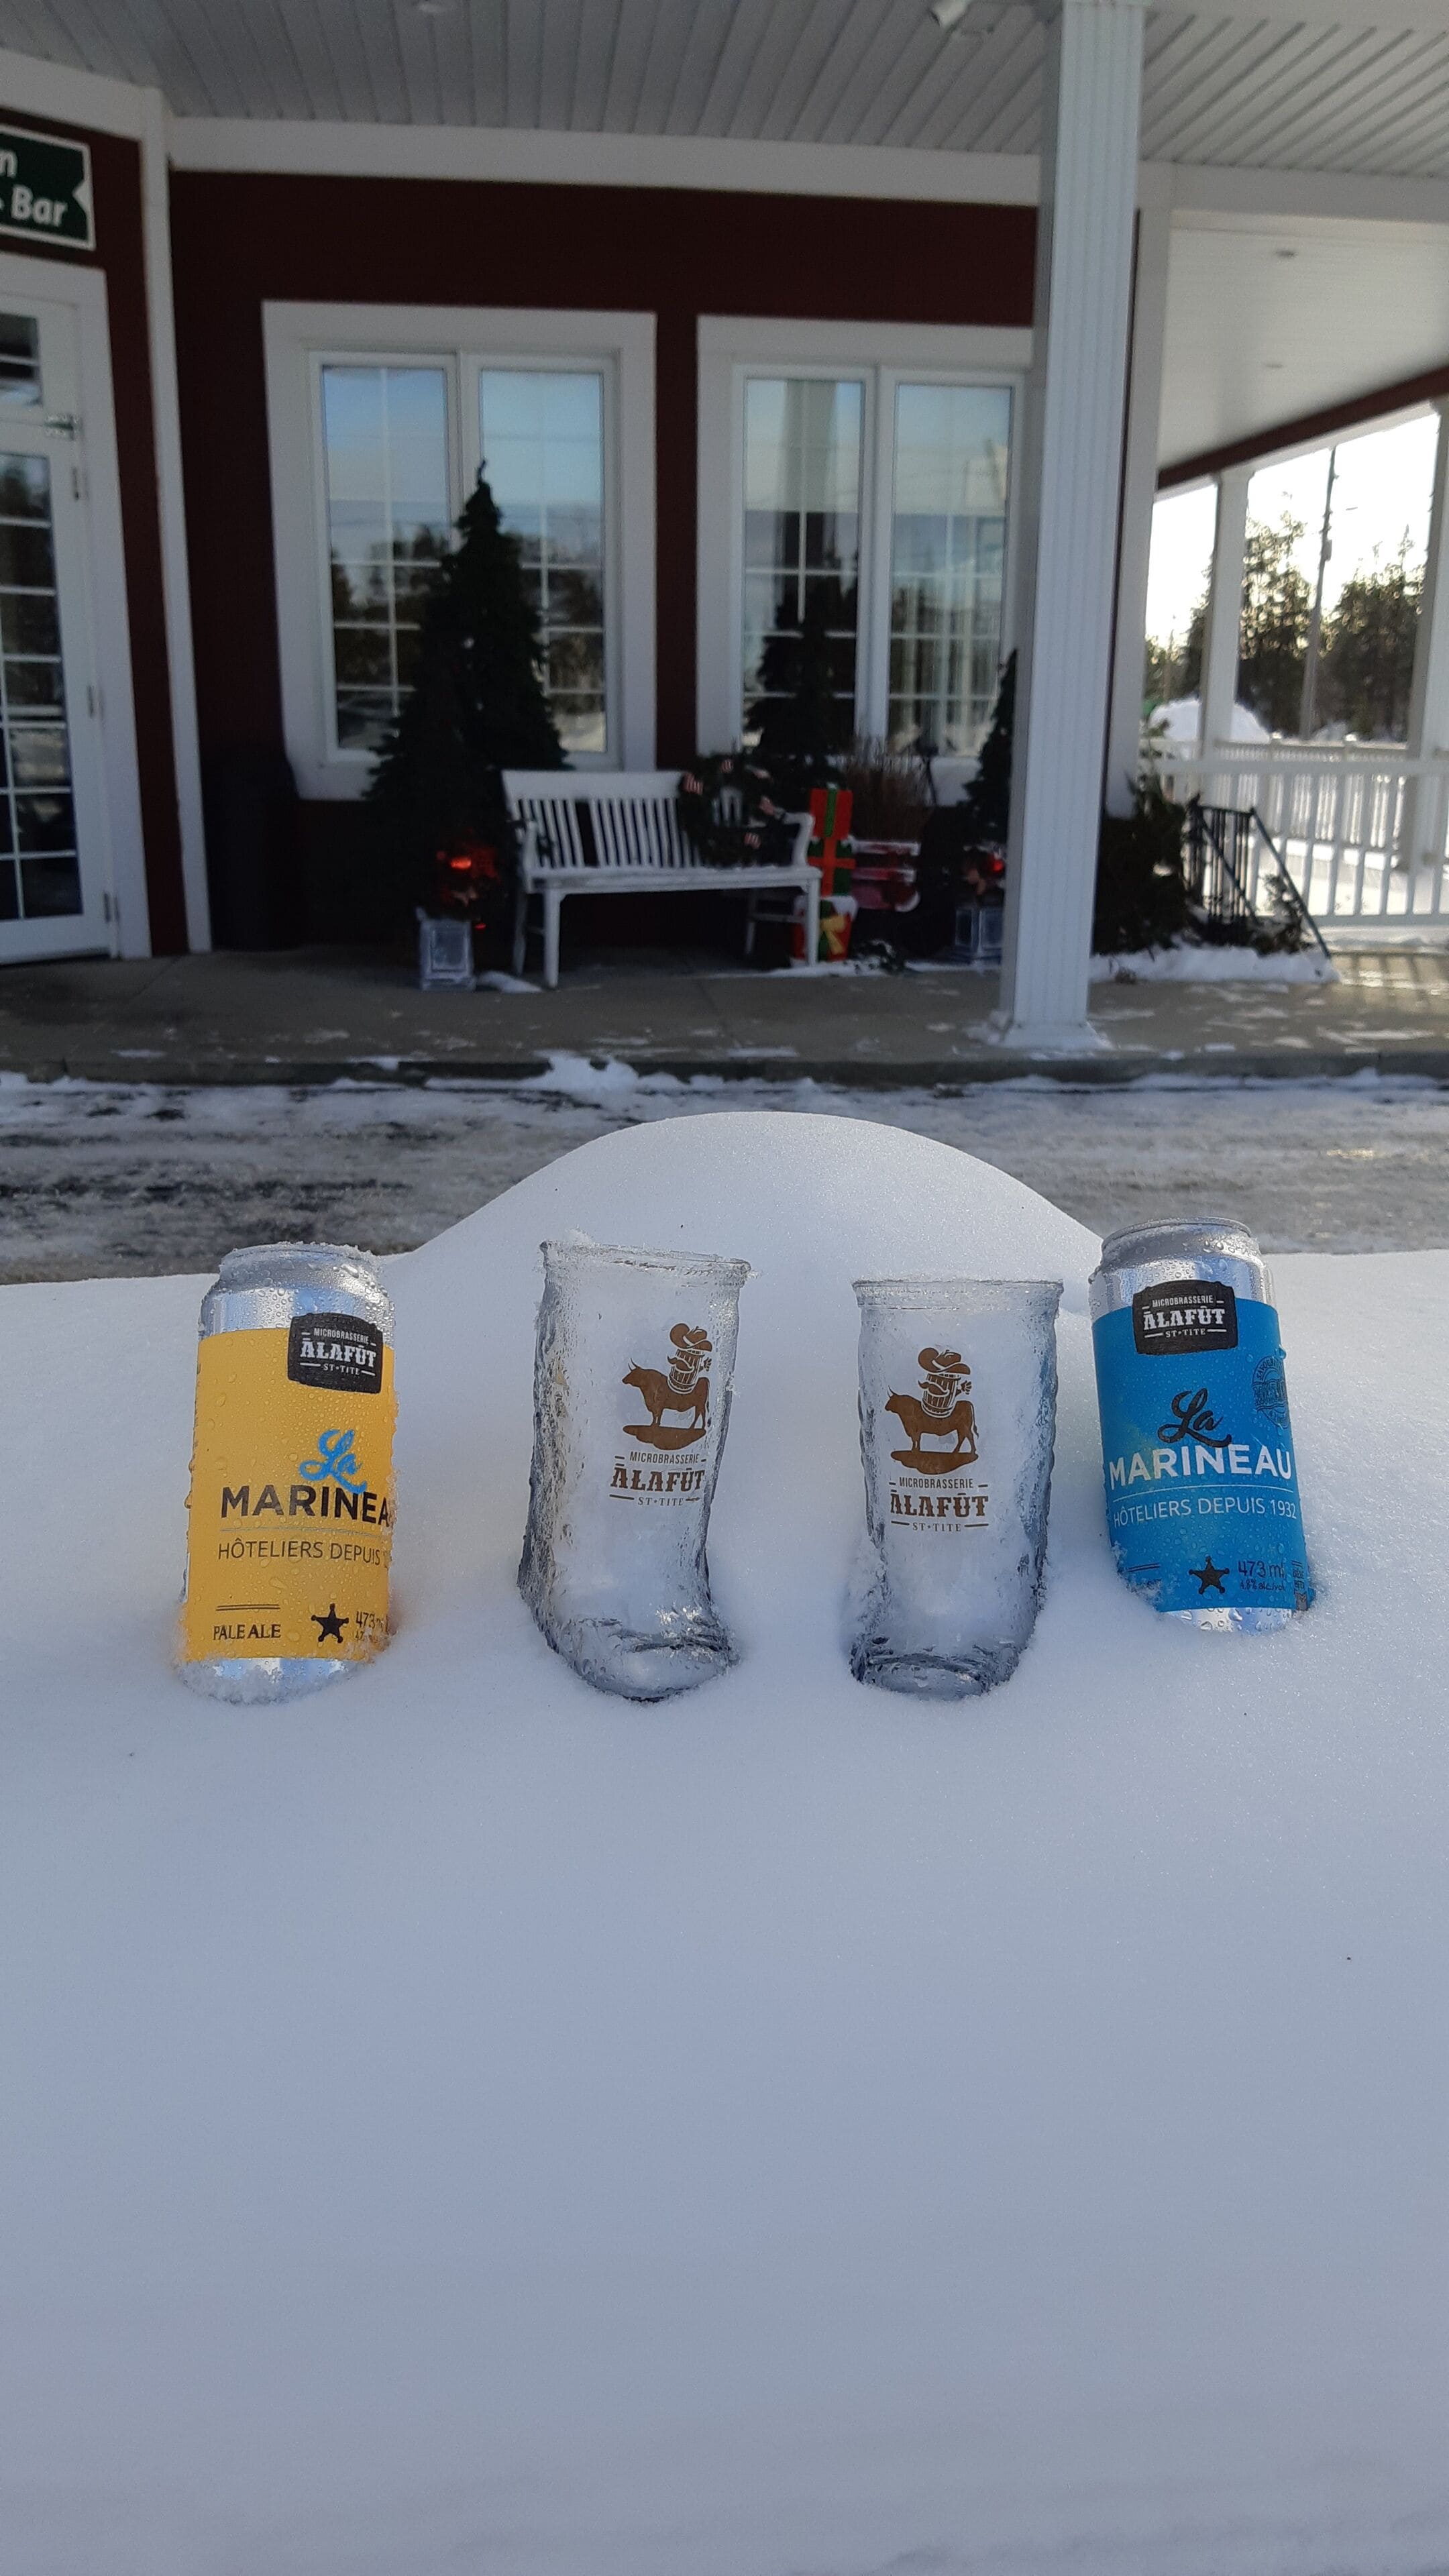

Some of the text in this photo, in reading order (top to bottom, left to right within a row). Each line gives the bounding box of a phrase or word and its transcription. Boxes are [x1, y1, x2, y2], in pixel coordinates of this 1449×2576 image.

[11, 184, 68, 227] Bar
[1152, 1295, 1214, 1307] MICROBRASSERIE
[313, 1328, 369, 1344] MICROBRASSERIE
[1157, 1388, 1232, 1448] La
[299, 1429, 368, 1494] La
[630, 1451, 700, 1464] MICROBRASSERIE
[1109, 1444, 1292, 1490] MARINEAU
[899, 1477, 973, 1489] MICROBRASSERIE
[1114, 1497, 1297, 1529] HÔTELIERS DEPUIS 1932
[218, 1538, 323, 1560] HÔTELIERS
[330, 1542, 380, 1566] DEPUIS
[1238, 1560, 1267, 1578] 473
[356, 1611, 375, 1629] 473
[213, 1623, 281, 1641] PALE ALE
